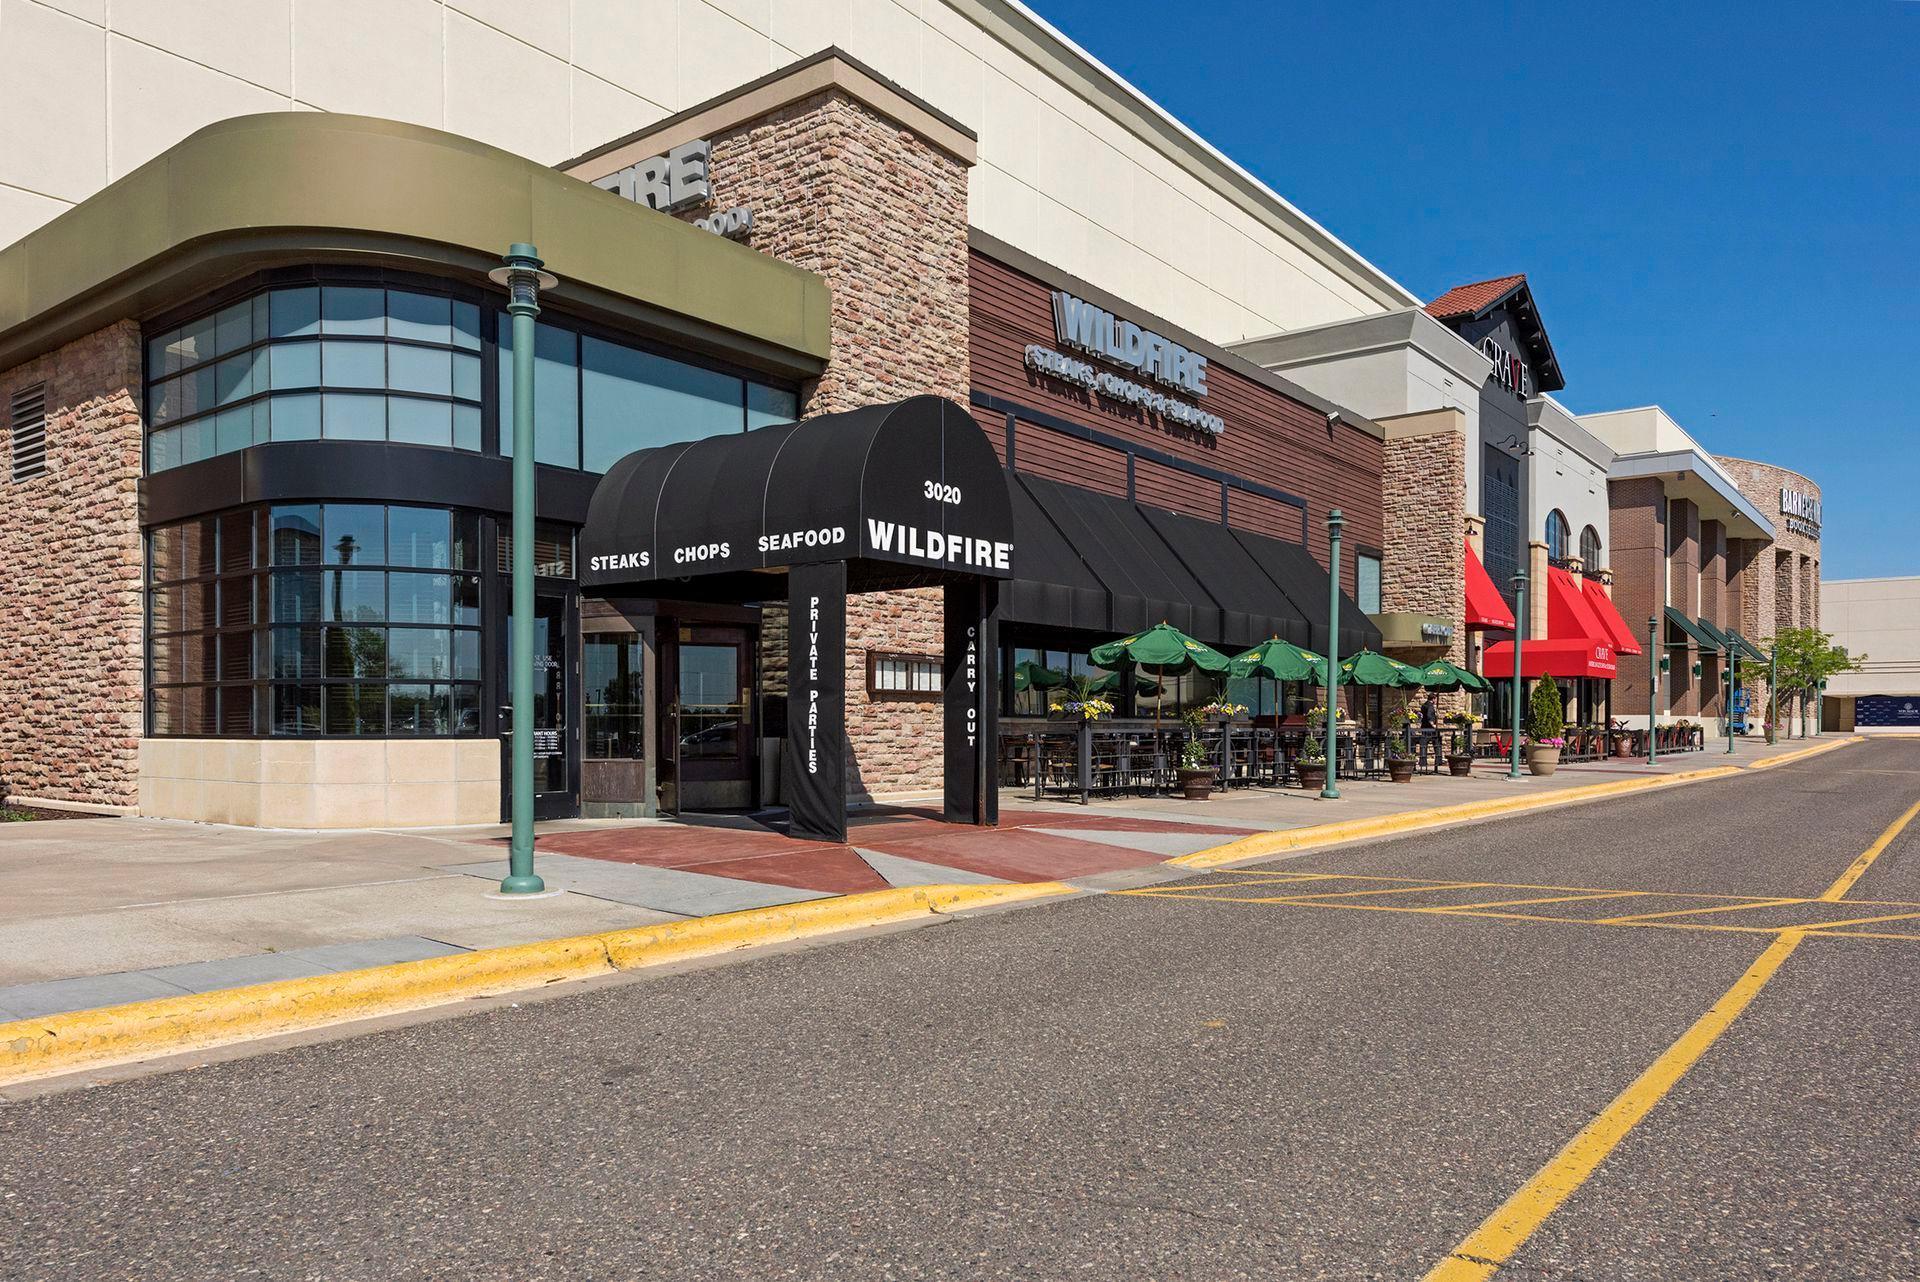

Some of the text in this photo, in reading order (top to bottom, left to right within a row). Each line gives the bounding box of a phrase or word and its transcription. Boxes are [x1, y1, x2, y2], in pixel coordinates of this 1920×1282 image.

[1052, 290, 1208, 398] WILDFIRE
[1483, 336, 1528, 397] CRAVE
[1096, 373, 1152, 408] CHOPS
[1163, 399, 1225, 435] SEAFOOD
[924, 480, 961, 504] 3020
[590, 551, 650, 571] STEAKS
[674, 542, 731, 563] CHOPS
[758, 527, 846, 552] SEAFOOD
[808, 596, 820, 774] PRIVATE PARTIES
[966, 626, 976, 747] CARRY OUT
